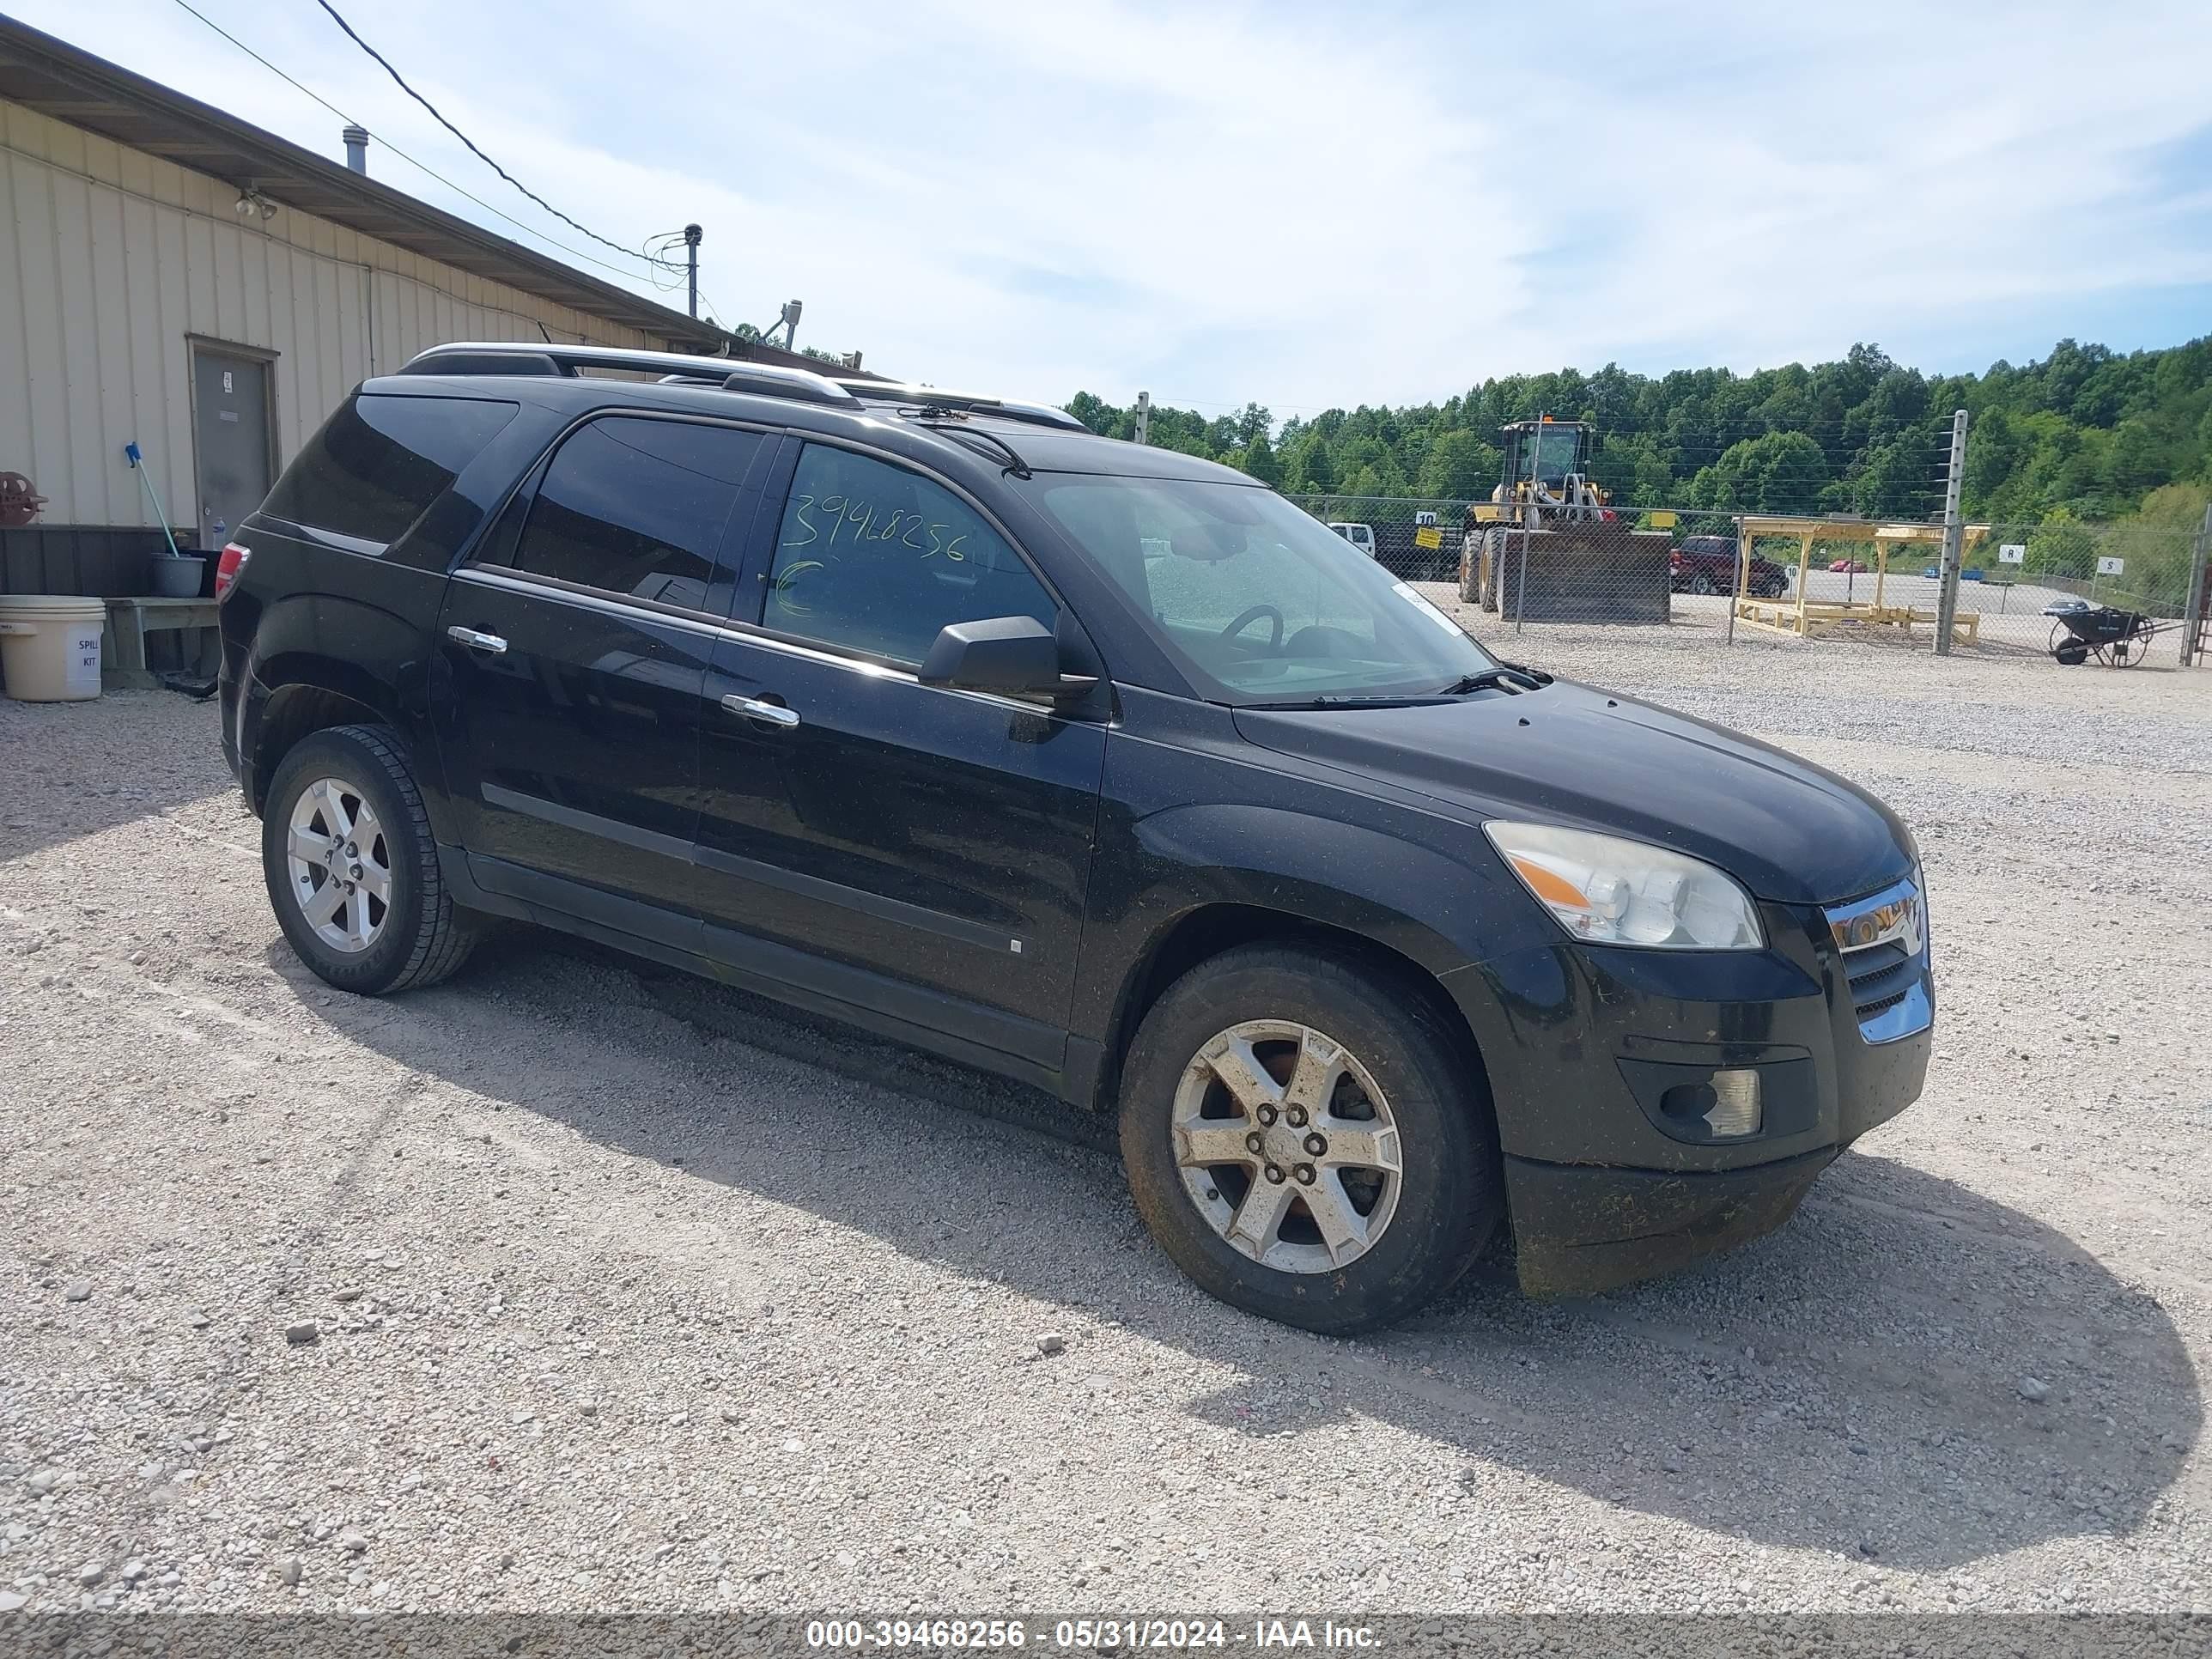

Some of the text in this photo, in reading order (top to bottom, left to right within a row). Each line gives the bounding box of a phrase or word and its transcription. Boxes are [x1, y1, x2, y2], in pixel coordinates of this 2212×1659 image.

[2007, 549, 2014, 559] R
[2106, 561, 2114, 571] S
[1788, 567, 1796, 577] 10
[79, 640, 99, 650] SPILL
[83, 657, 96, 666] KIT
